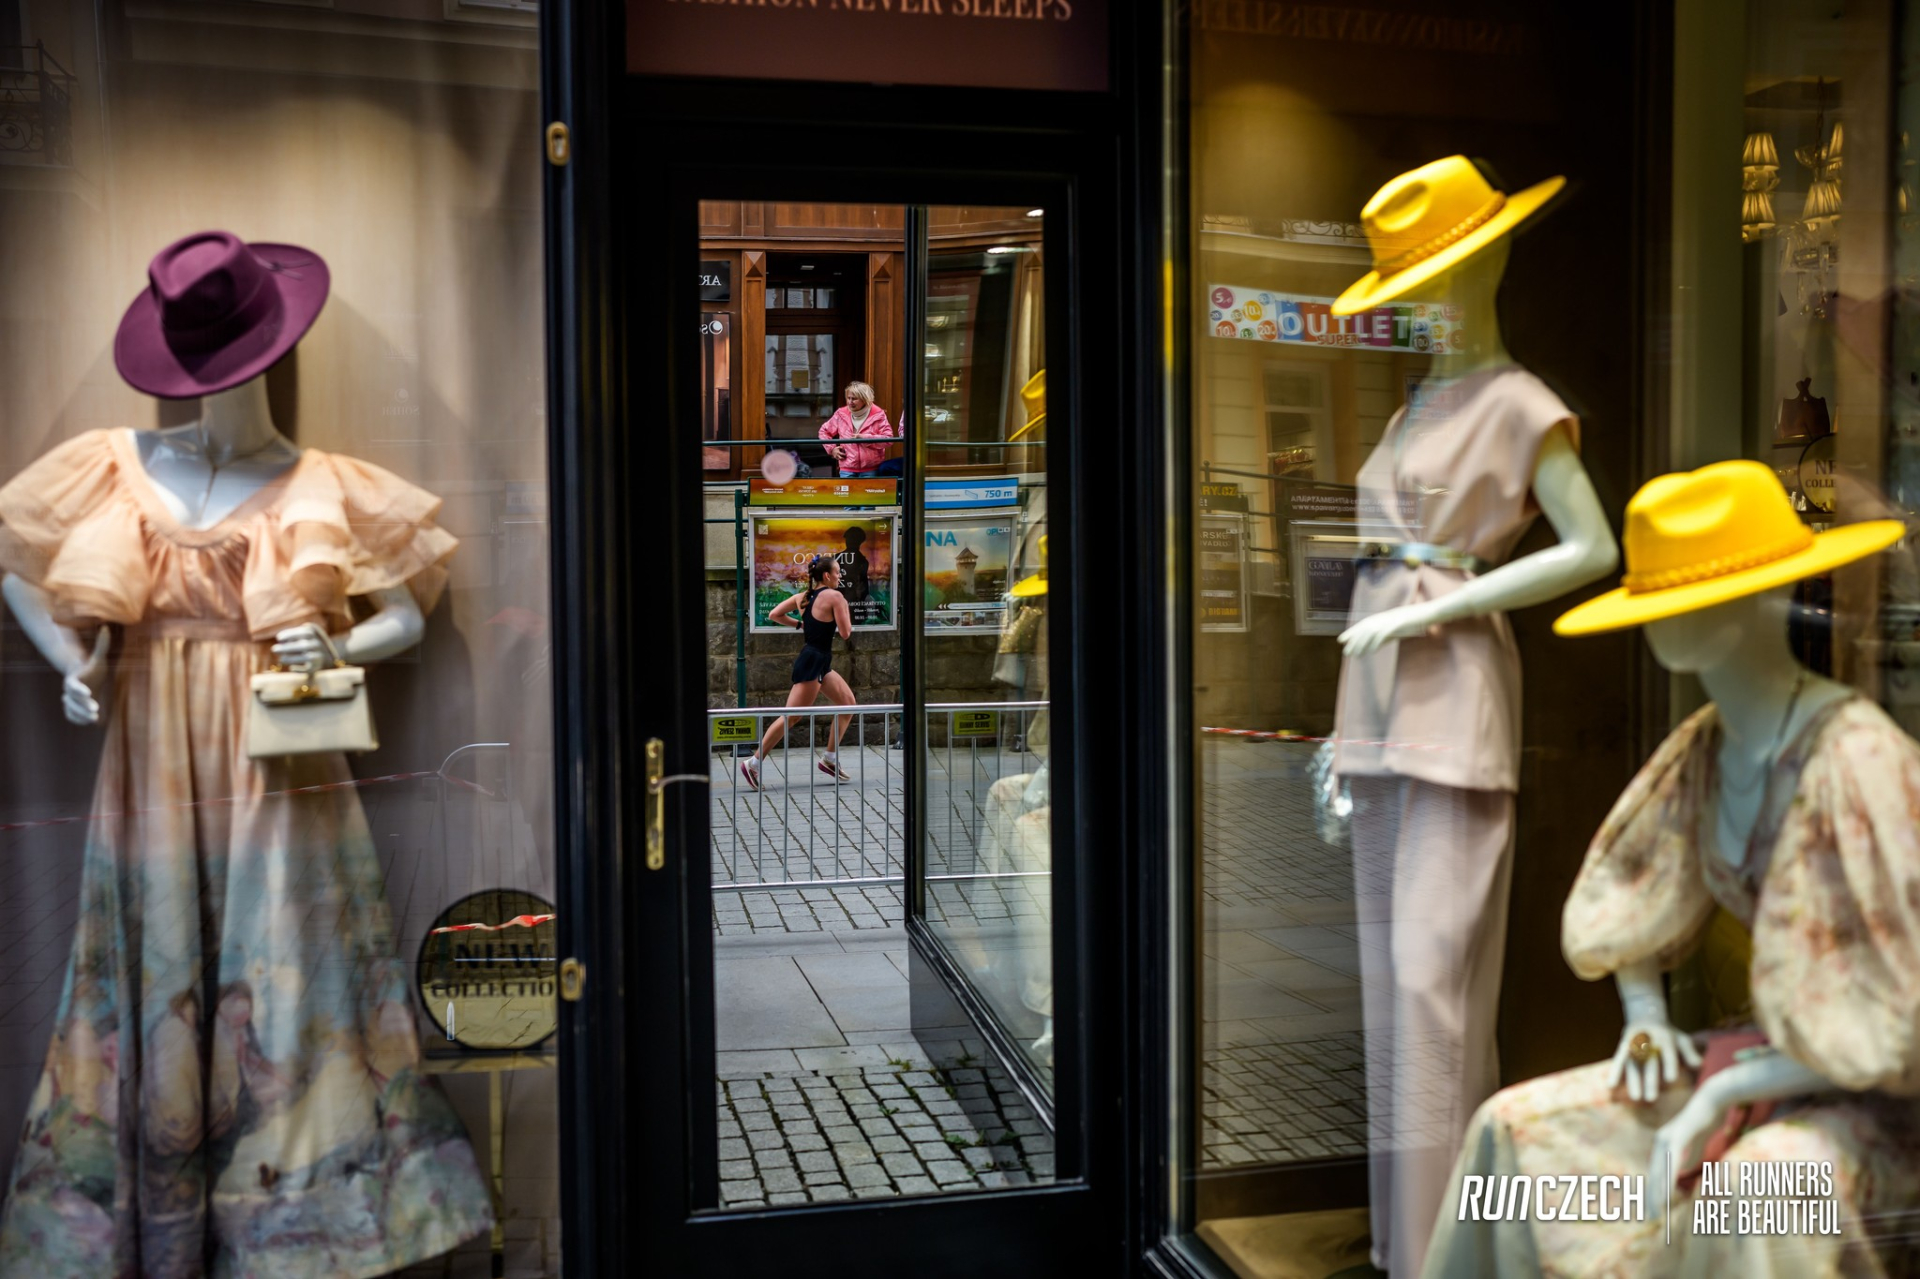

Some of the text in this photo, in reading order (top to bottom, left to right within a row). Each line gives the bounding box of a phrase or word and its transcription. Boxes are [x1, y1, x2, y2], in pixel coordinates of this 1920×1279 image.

[1278, 312, 1411, 339] OUTLET
[985, 490, 1001, 498] 750
[925, 531, 957, 547] NA
[455, 943, 549, 969] NEW
